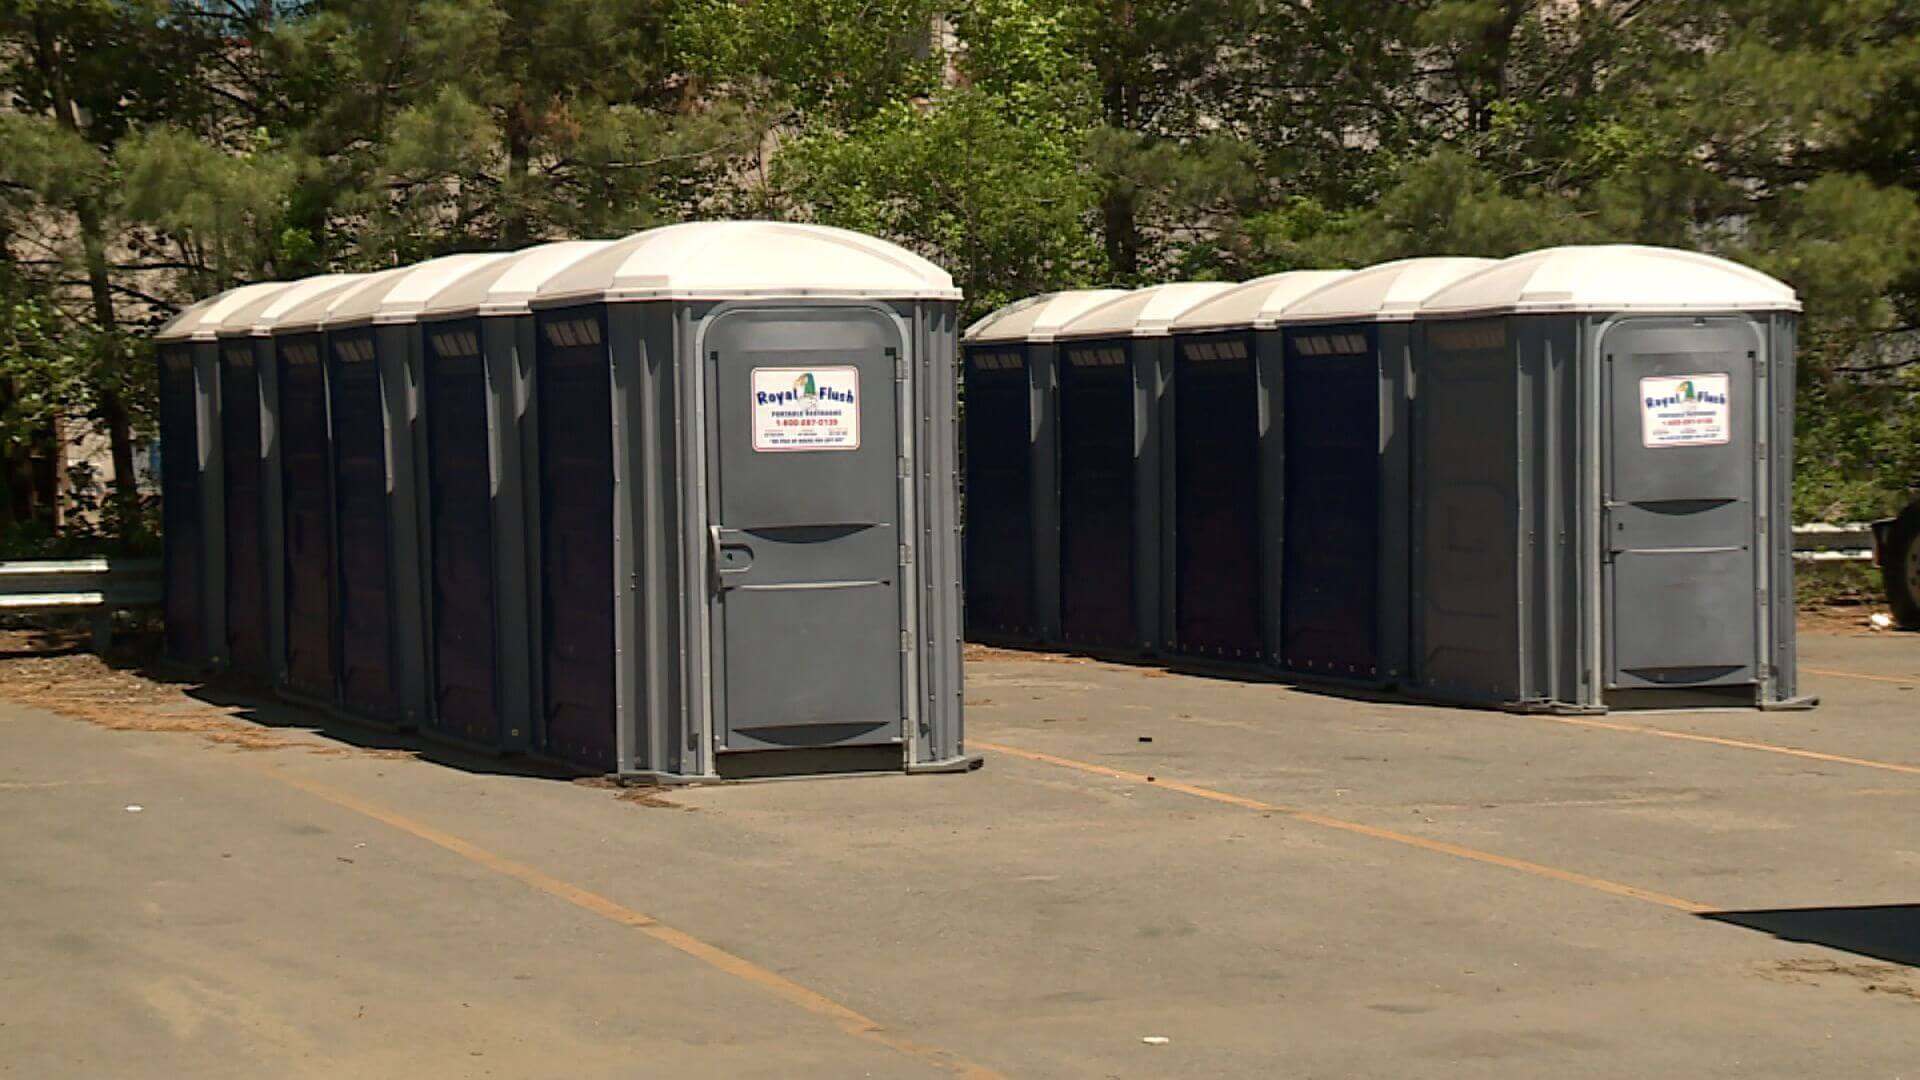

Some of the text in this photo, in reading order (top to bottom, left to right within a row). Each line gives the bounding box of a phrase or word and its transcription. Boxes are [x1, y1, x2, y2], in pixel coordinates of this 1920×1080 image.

[757, 386, 854, 405] Royal Flush
[1646, 393, 1680, 409] Royal
